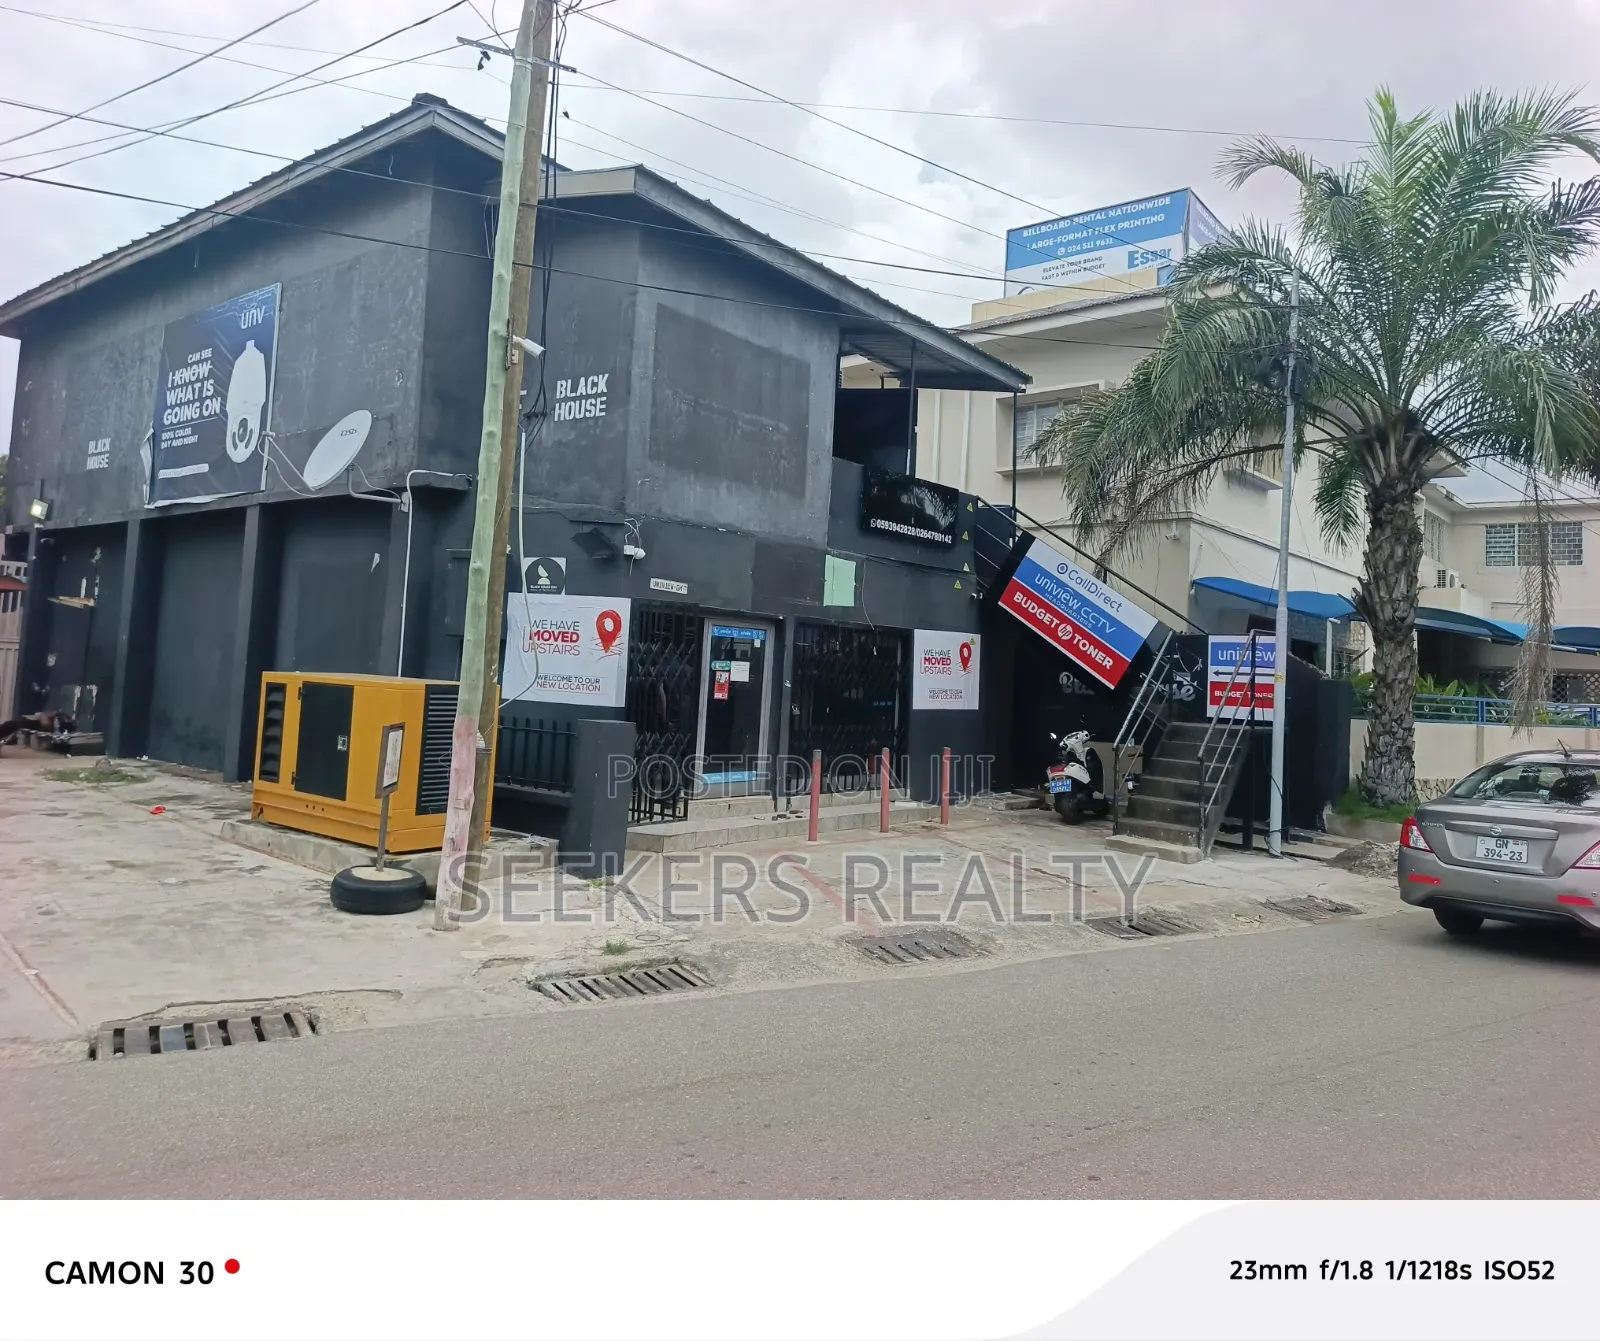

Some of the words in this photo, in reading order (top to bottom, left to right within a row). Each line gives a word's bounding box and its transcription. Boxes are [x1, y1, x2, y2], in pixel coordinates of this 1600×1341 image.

[1023, 220, 1071, 238] BILLBOARD
[1072, 211, 1106, 225] RENTAL
[1108, 196, 1171, 218] NATIONWIDE
[1027, 228, 1093, 250] LARGE-FORMAT
[1094, 223, 1116, 235] FLEX
[1118, 213, 1166, 231] PRINTING
[1067, 244, 1081, 253] 024
[1082, 242, 1094, 250] 511
[1096, 238, 1114, 247] 9631
[1042, 263, 1066, 274] ELEVATE
[1083, 256, 1103, 264] BRAND
[1128, 248, 1172, 270] Essar
[1061, 268, 1082, 277] WITHIN
[1083, 262, 1106, 273] BUDGET
[188, 352, 200, 364] CAN
[201, 348, 213, 360] SEE
[173, 360, 212, 387] KNOW
[166, 381, 201, 407] WHAT
[202, 379, 214, 397] IS
[556, 373, 609, 399] BLACK
[163, 402, 200, 426] GOING
[202, 396, 222, 417] ON
[554, 396, 607, 422] HOUSE
[88, 437, 112, 454] BLACK
[86, 454, 110, 470] HOUSE
[1068, 569, 1123, 613] CallDirect
[1034, 573, 1082, 610] uniview
[1081, 606, 1116, 634] CCTV
[1044, 592, 1093, 629] HEADQUARTERS
[532, 620, 548, 630] WE
[550, 620, 580, 632] HAVE
[1013, 591, 1060, 629] BUDGET
[1072, 634, 1114, 670] TONER
[522, 635, 580, 656] UPSTAIRS
[529, 630, 580, 644] MOVED
[924, 656, 952, 666] MOVED
[935, 650, 952, 658] HAVE
[920, 661, 952, 676] UPSTAIRS
[538, 674, 572, 682] WELCOME
[574, 676, 584, 684] TO
[558, 682, 600, 692] LOCATION
[1495, 839, 1509, 850] GN
[1484, 848, 1522, 861] 394-23
